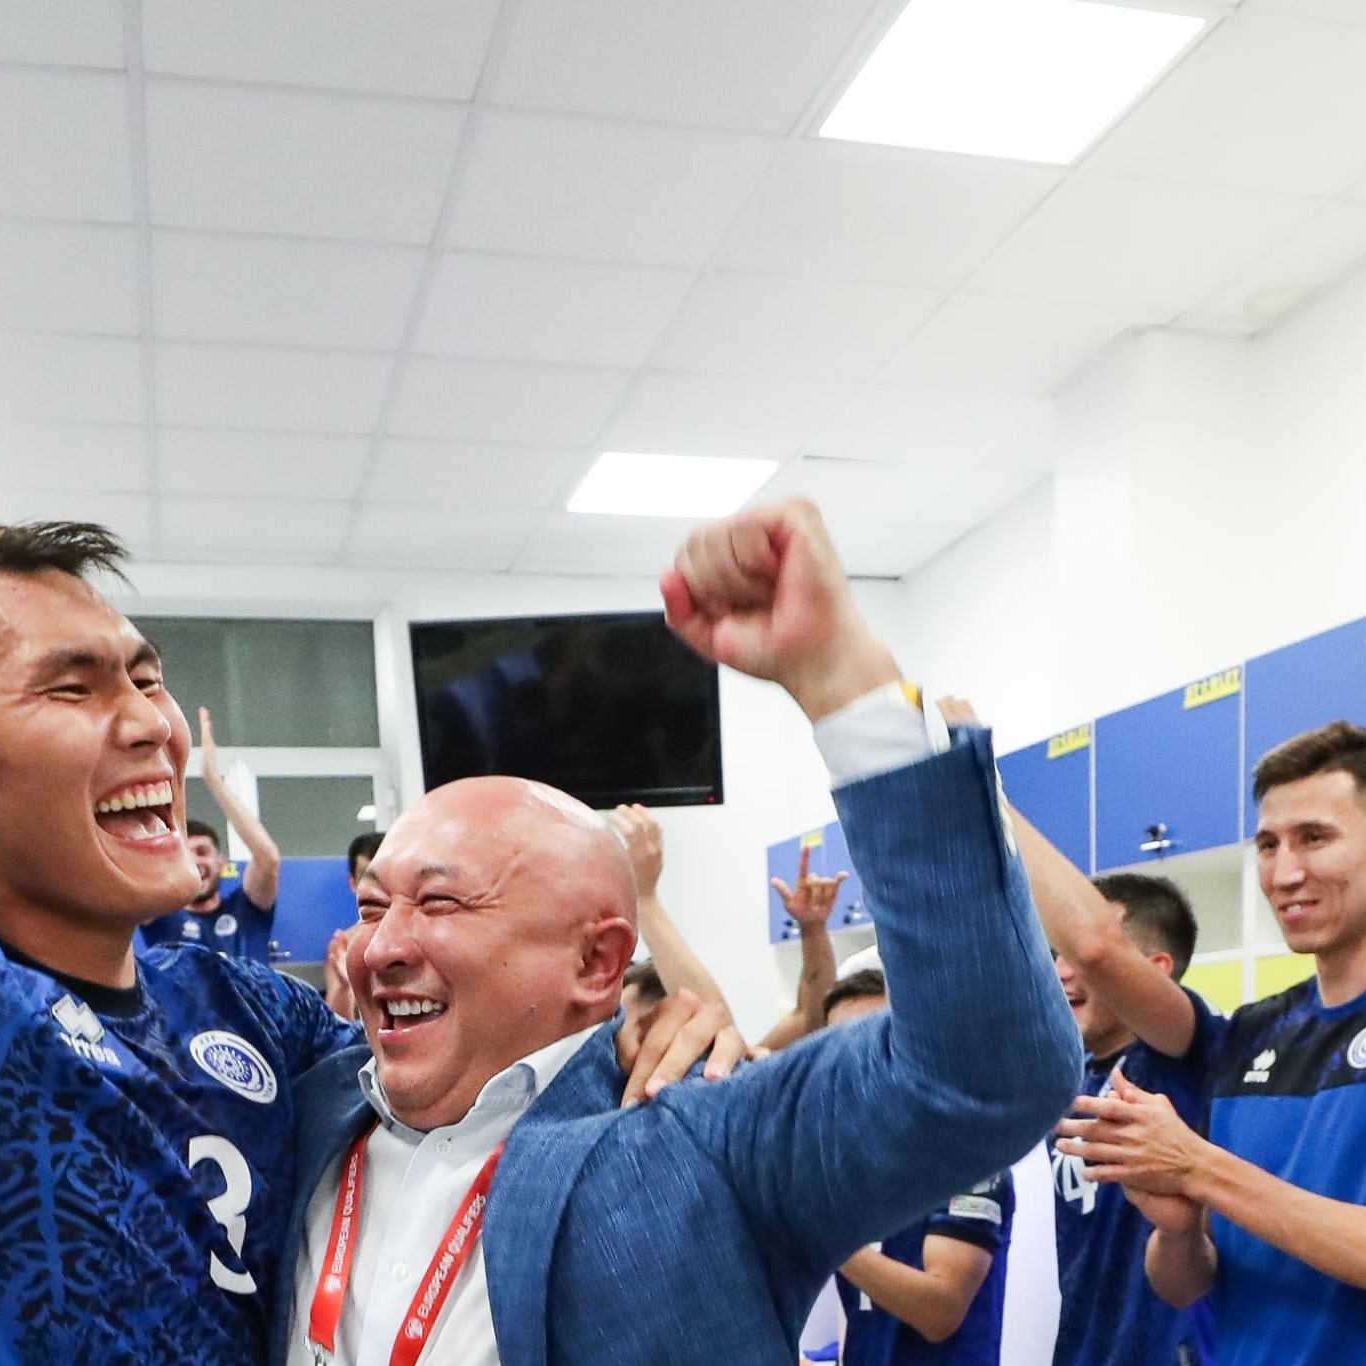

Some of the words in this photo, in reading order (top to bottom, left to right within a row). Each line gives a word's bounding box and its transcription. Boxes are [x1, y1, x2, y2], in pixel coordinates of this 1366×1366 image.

[189, 1135, 257, 1294] 3
[331, 1216, 351, 1274] EUROPEAN
[343, 1153, 358, 1215] QUALIFIERS
[417, 1252, 455, 1318] EUROPEAN
[448, 1192, 486, 1254] QUALIFIERS
